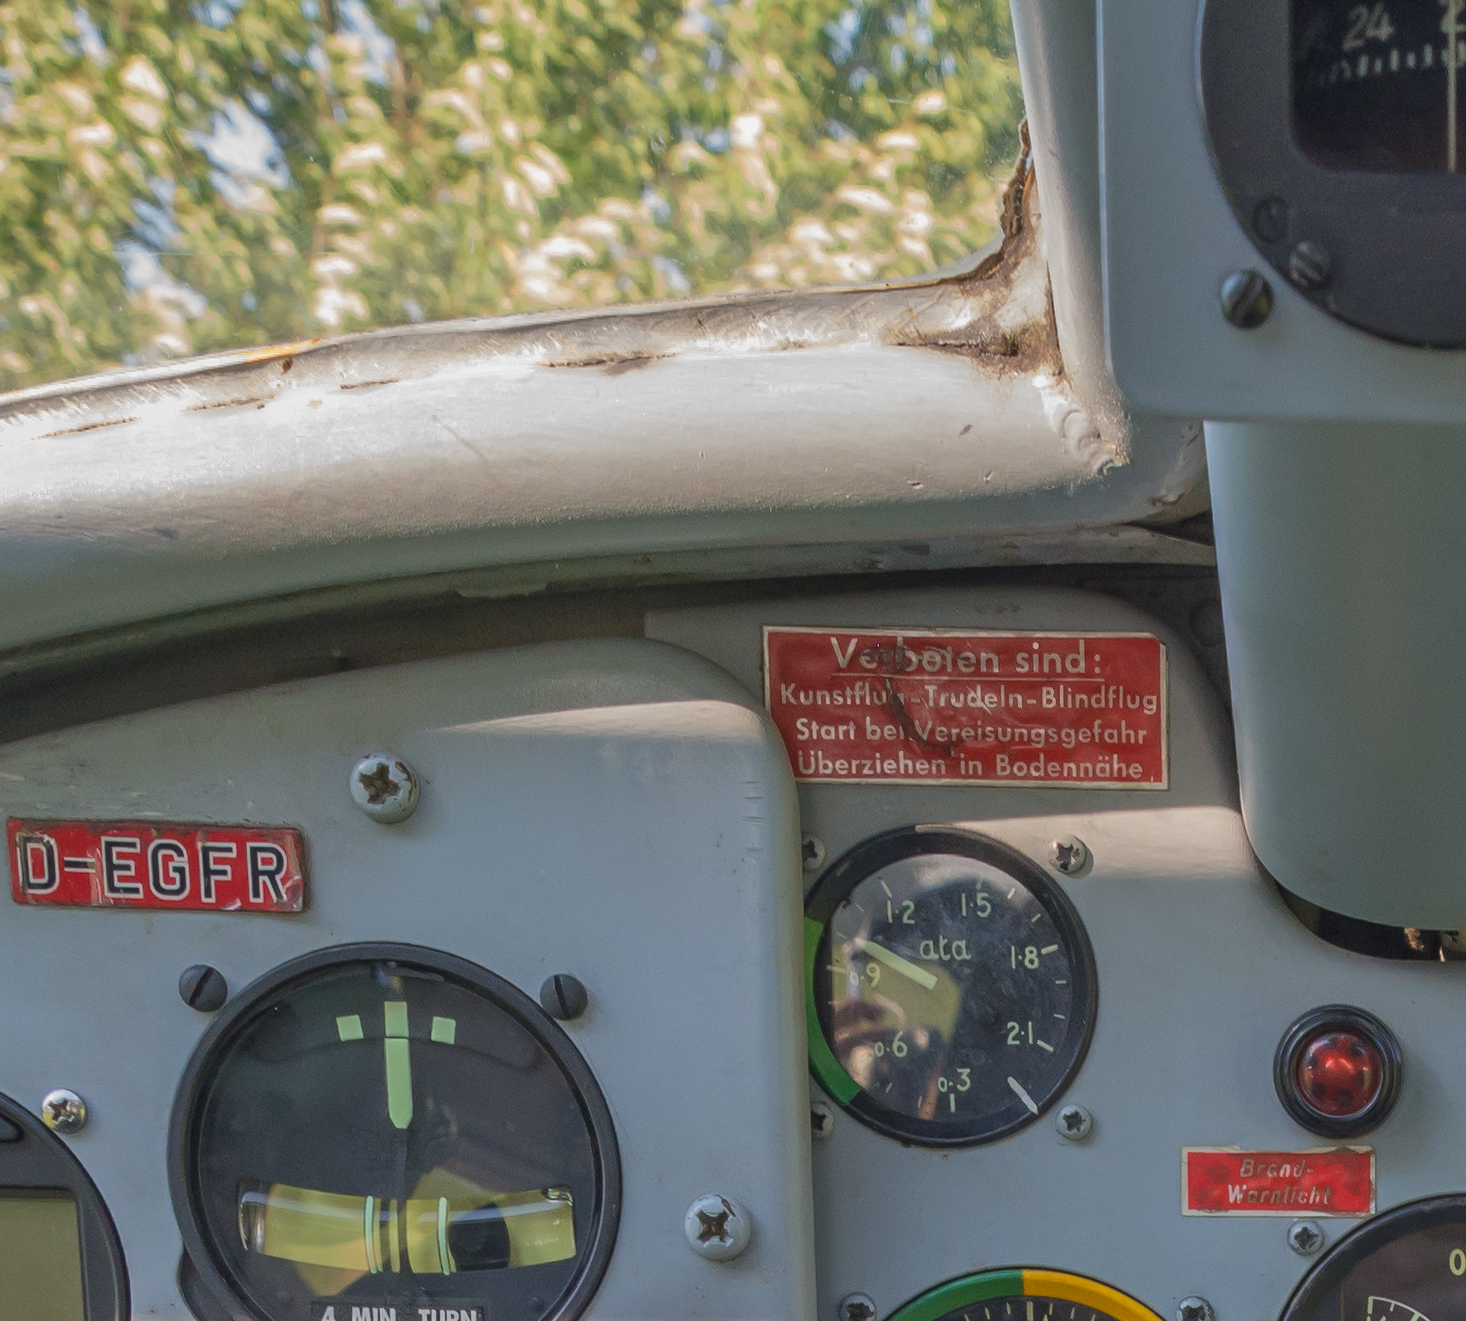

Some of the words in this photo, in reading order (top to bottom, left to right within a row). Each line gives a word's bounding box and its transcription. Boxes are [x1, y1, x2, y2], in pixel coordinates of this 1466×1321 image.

[1341, 11, 1394, 48] 24
[1015, 639, 1102, 675] sind:
[796, 719, 855, 741] Start
[866, 717, 904, 740] bei
[915, 721, 1147, 745] Vereisungsgefahr
[798, 752, 947, 775] Überziehen
[961, 757, 982, 776] in
[996, 755, 1143, 779] Bodennähe
[16, 832, 288, 903] D-EGFR
[920, 936, 971, 960] ata
